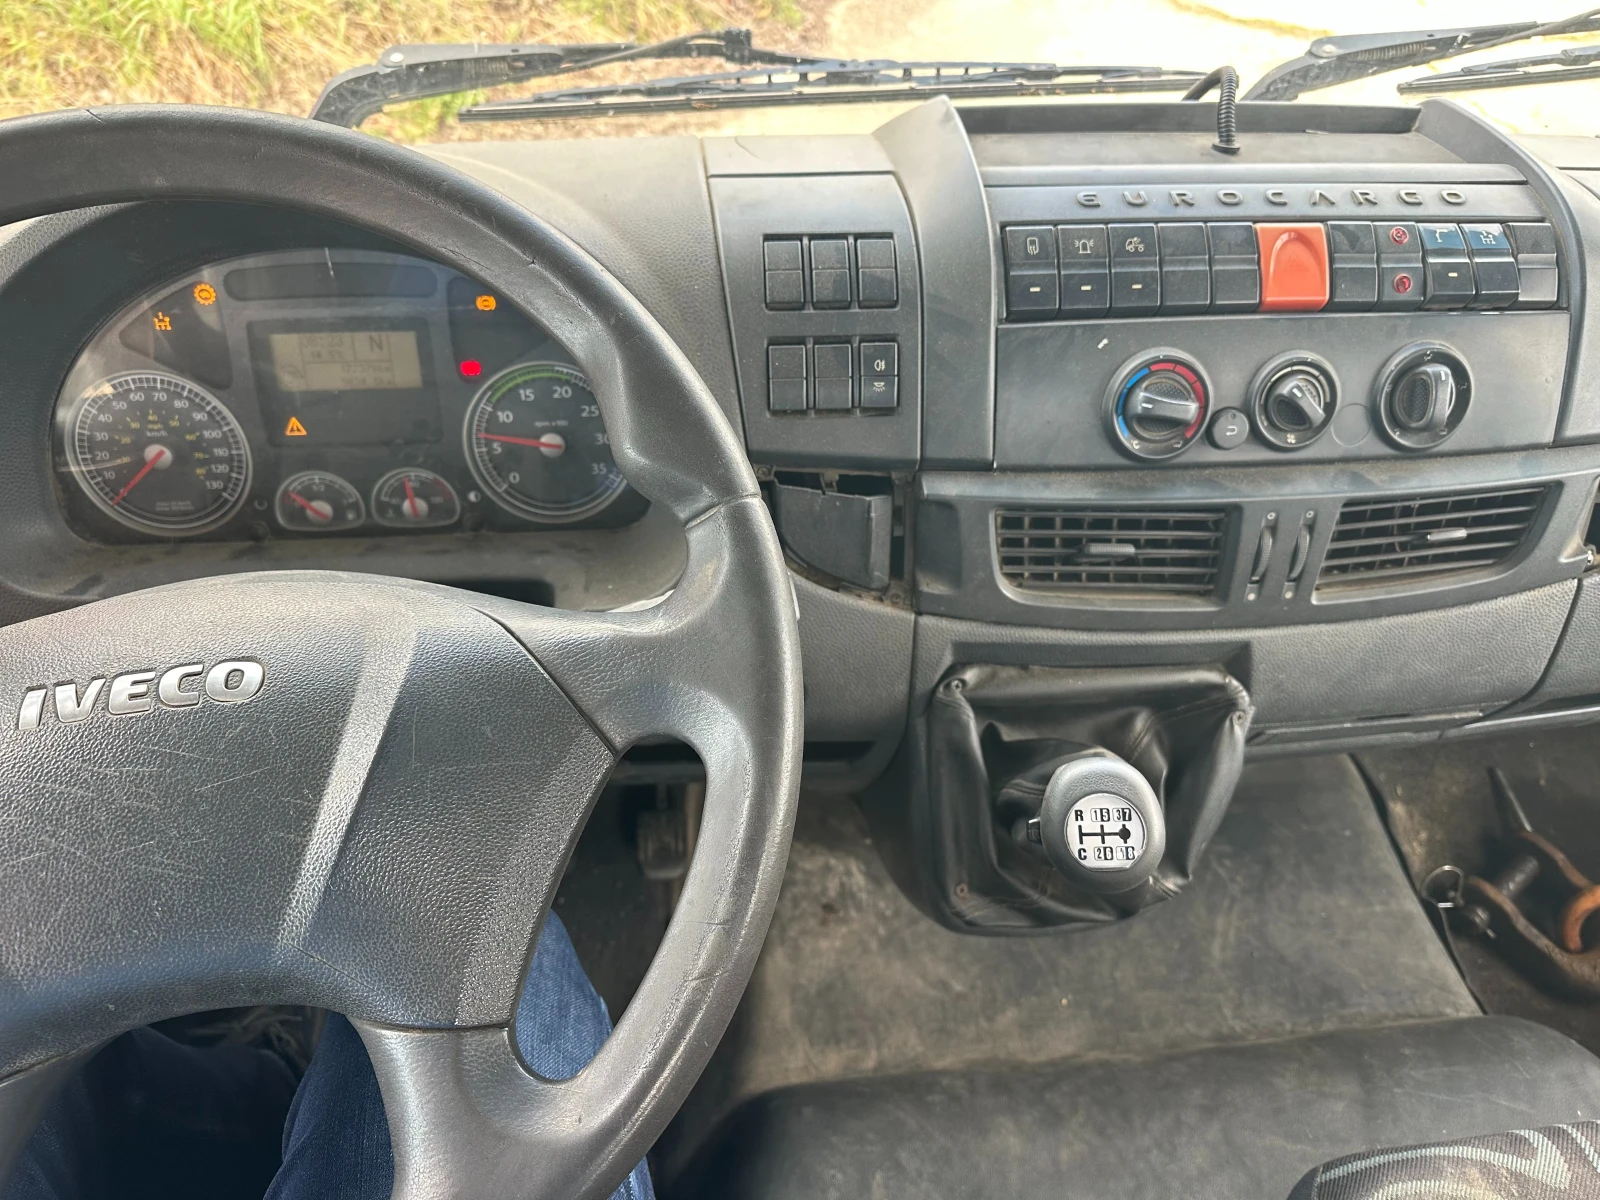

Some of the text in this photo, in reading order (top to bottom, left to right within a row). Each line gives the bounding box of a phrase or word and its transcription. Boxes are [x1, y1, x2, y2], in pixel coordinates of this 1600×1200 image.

[1076, 189, 1468, 208] EUROCARGO
[369, 334, 384, 352] N
[129, 392, 145, 402] 60
[152, 392, 167, 402] 70
[519, 388, 535, 402] 15
[552, 385, 572, 398] 20
[112, 401, 127, 411] 50
[174, 399, 189, 409] 80
[192, 412, 208, 422] 90
[497, 410, 514, 424] 10
[580, 405, 599, 418] 25
[98, 413, 113, 423] 40
[94, 432, 109, 442] 30
[202, 430, 222, 440] 100
[212, 448, 229, 458] 110
[492, 442, 502, 454] 5
[94, 451, 110, 461] 20
[210, 463, 230, 474] 120
[591, 463, 607, 475] 35
[103, 470, 116, 480] 10
[509, 472, 520, 484] 0
[205, 480, 224, 490] 130
[18, 660, 265, 731] IVECO
[1074, 809, 1084, 822] R
[1077, 848, 1088, 861] C
